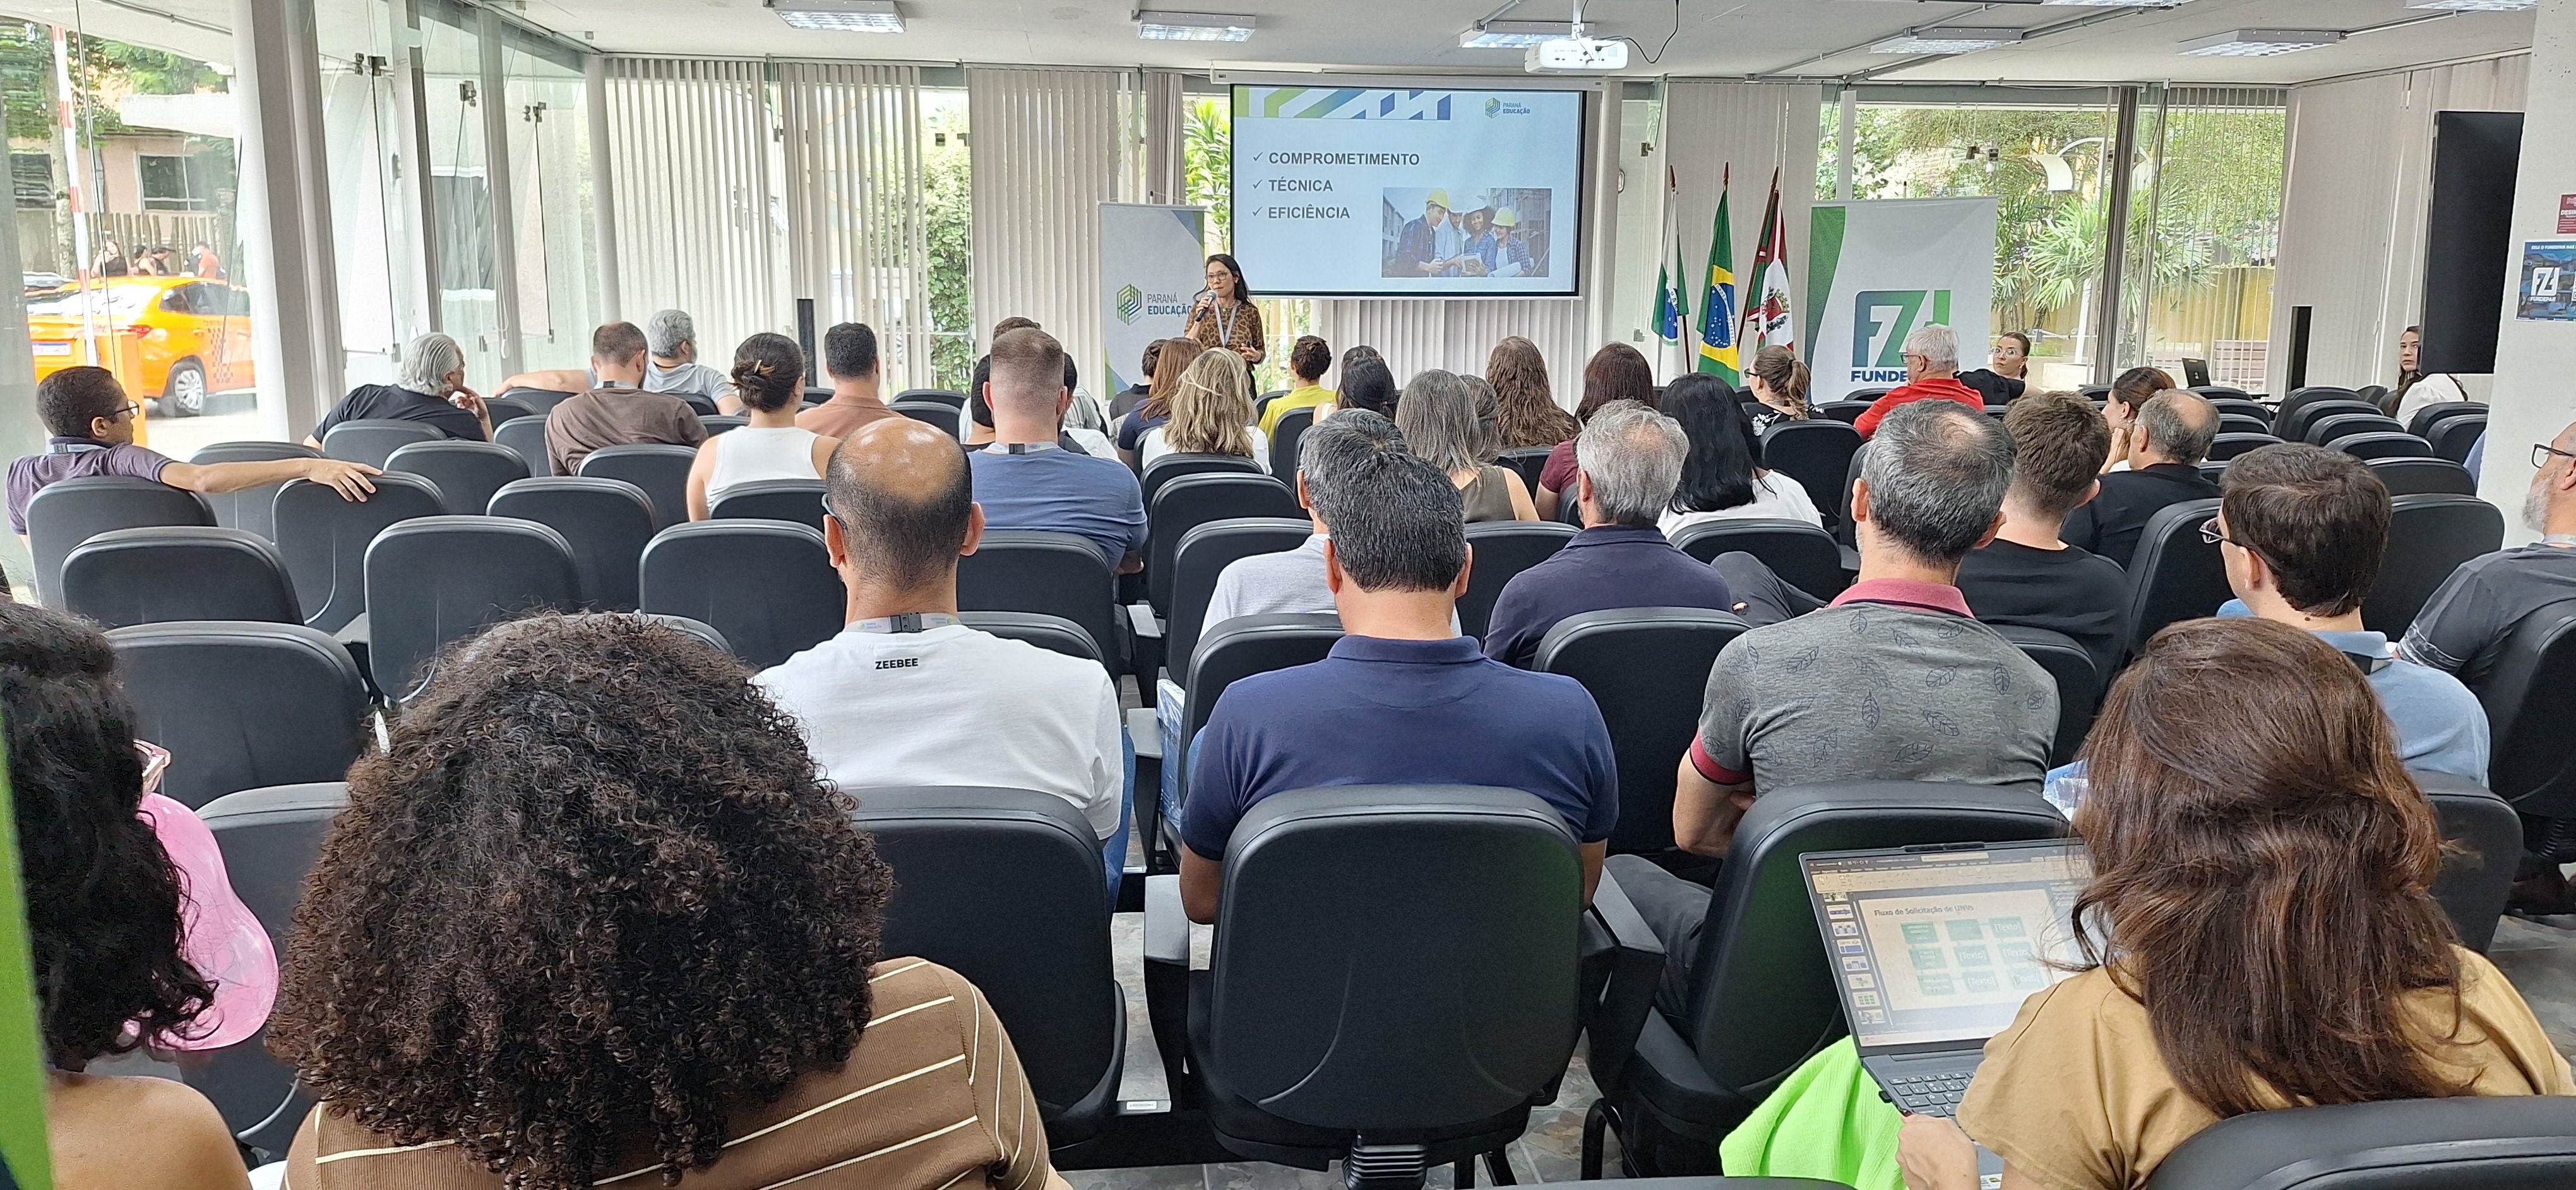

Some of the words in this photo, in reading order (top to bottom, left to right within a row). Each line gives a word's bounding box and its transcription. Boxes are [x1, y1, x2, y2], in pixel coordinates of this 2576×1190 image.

[1503, 107, 1530, 116] EDUCAÇÃO
[1268, 152, 1420, 166] COMPROMETIMENTO
[1268, 176, 1333, 192] TÉCNICA
[1268, 203, 1351, 219] EFICIÊNCIA
[1147, 292, 1178, 303] PARANÁ
[1851, 370, 1907, 382] FUNDE
[875, 658, 919, 670] ZEEBEE
[1905, 906, 1943, 915] Solicitação
